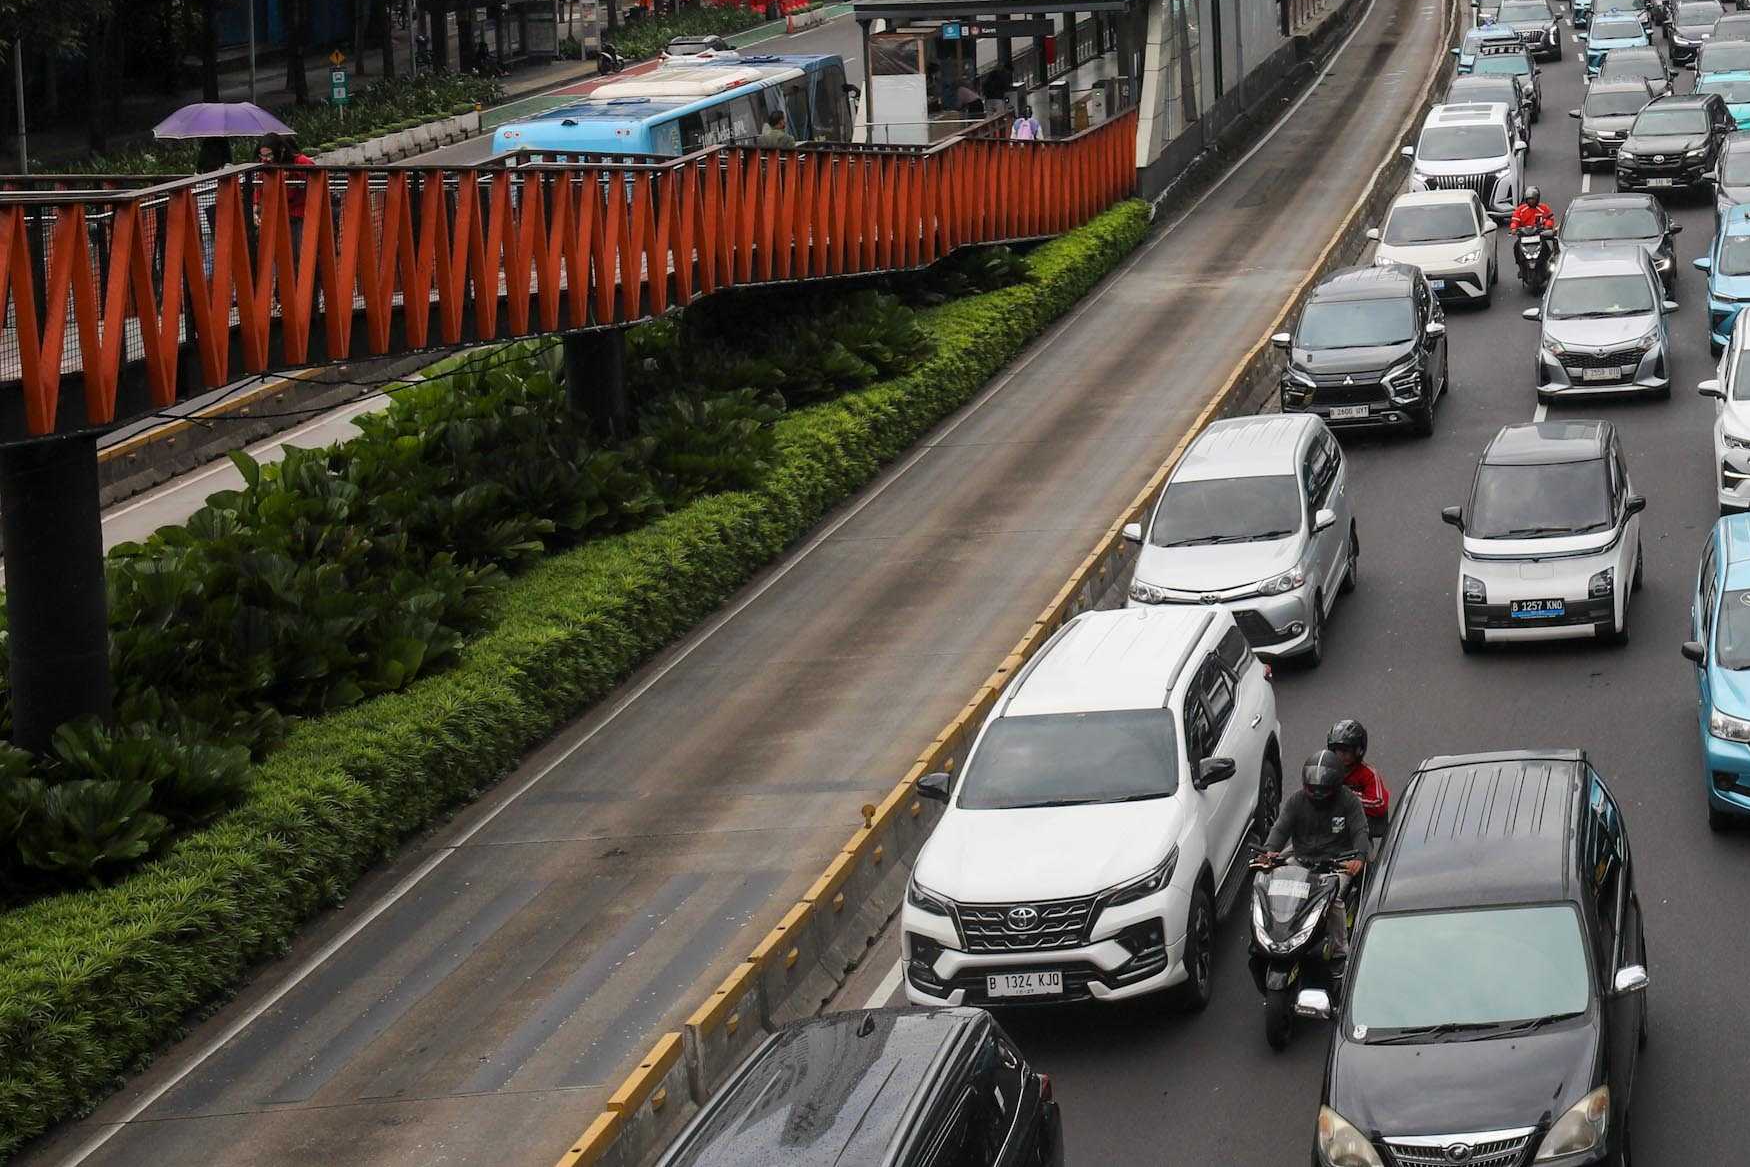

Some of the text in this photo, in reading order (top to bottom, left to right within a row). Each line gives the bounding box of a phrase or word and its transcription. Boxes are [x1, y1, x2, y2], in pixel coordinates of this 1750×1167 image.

[1512, 601, 1519, 612] B
[1522, 600, 1543, 611] 1257
[989, 977, 997, 990] B
[1005, 975, 1032, 989] 1324
